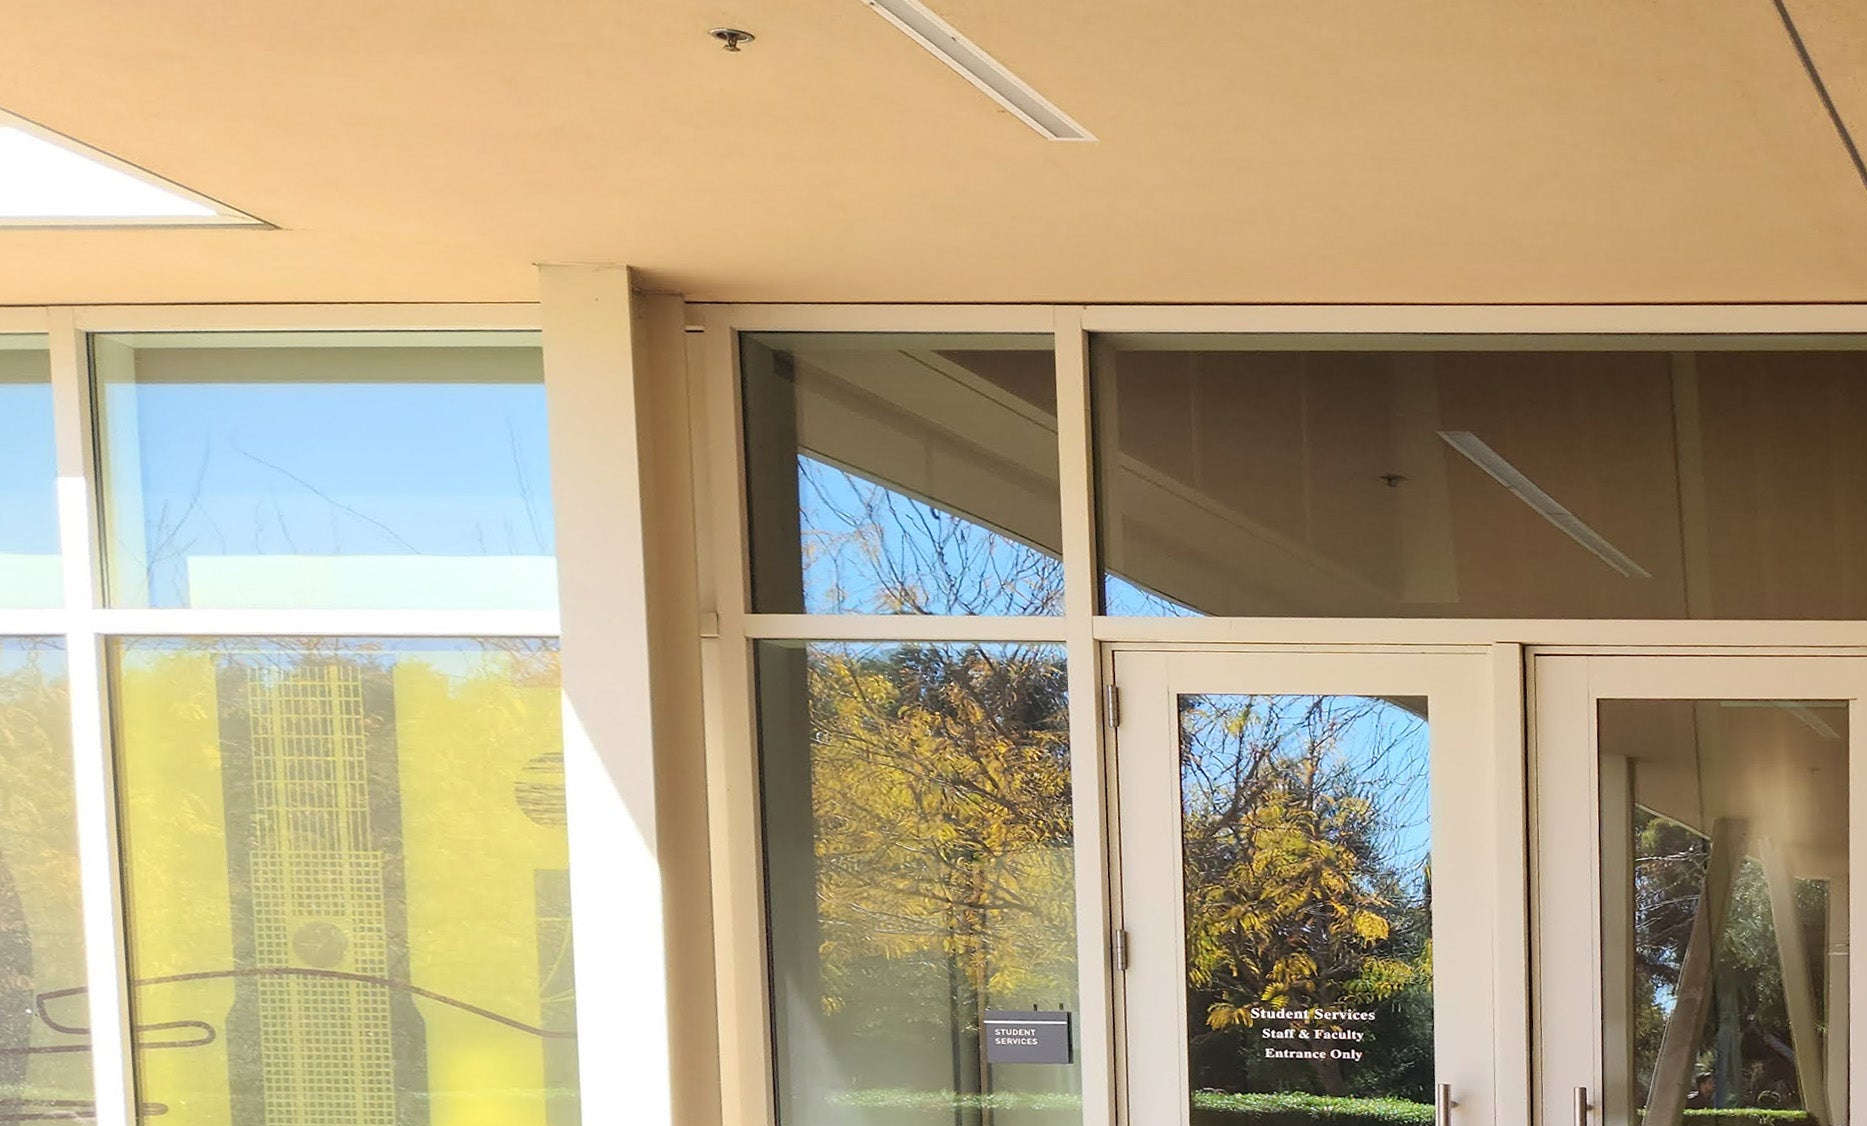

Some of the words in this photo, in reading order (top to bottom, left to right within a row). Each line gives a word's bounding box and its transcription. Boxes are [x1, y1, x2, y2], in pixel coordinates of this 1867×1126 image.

[1250, 1007, 1309, 1020] Student
[1314, 1008, 1376, 1021] Services
[994, 1028, 1036, 1036] STUDENT
[1262, 1028, 1295, 1039] Staff
[1298, 1029, 1310, 1040] &
[1314, 1029, 1364, 1042] Faculty
[994, 1037, 1038, 1045] SERVICES
[1264, 1048, 1326, 1059] Entrance
[1330, 1049, 1363, 1062] Only
